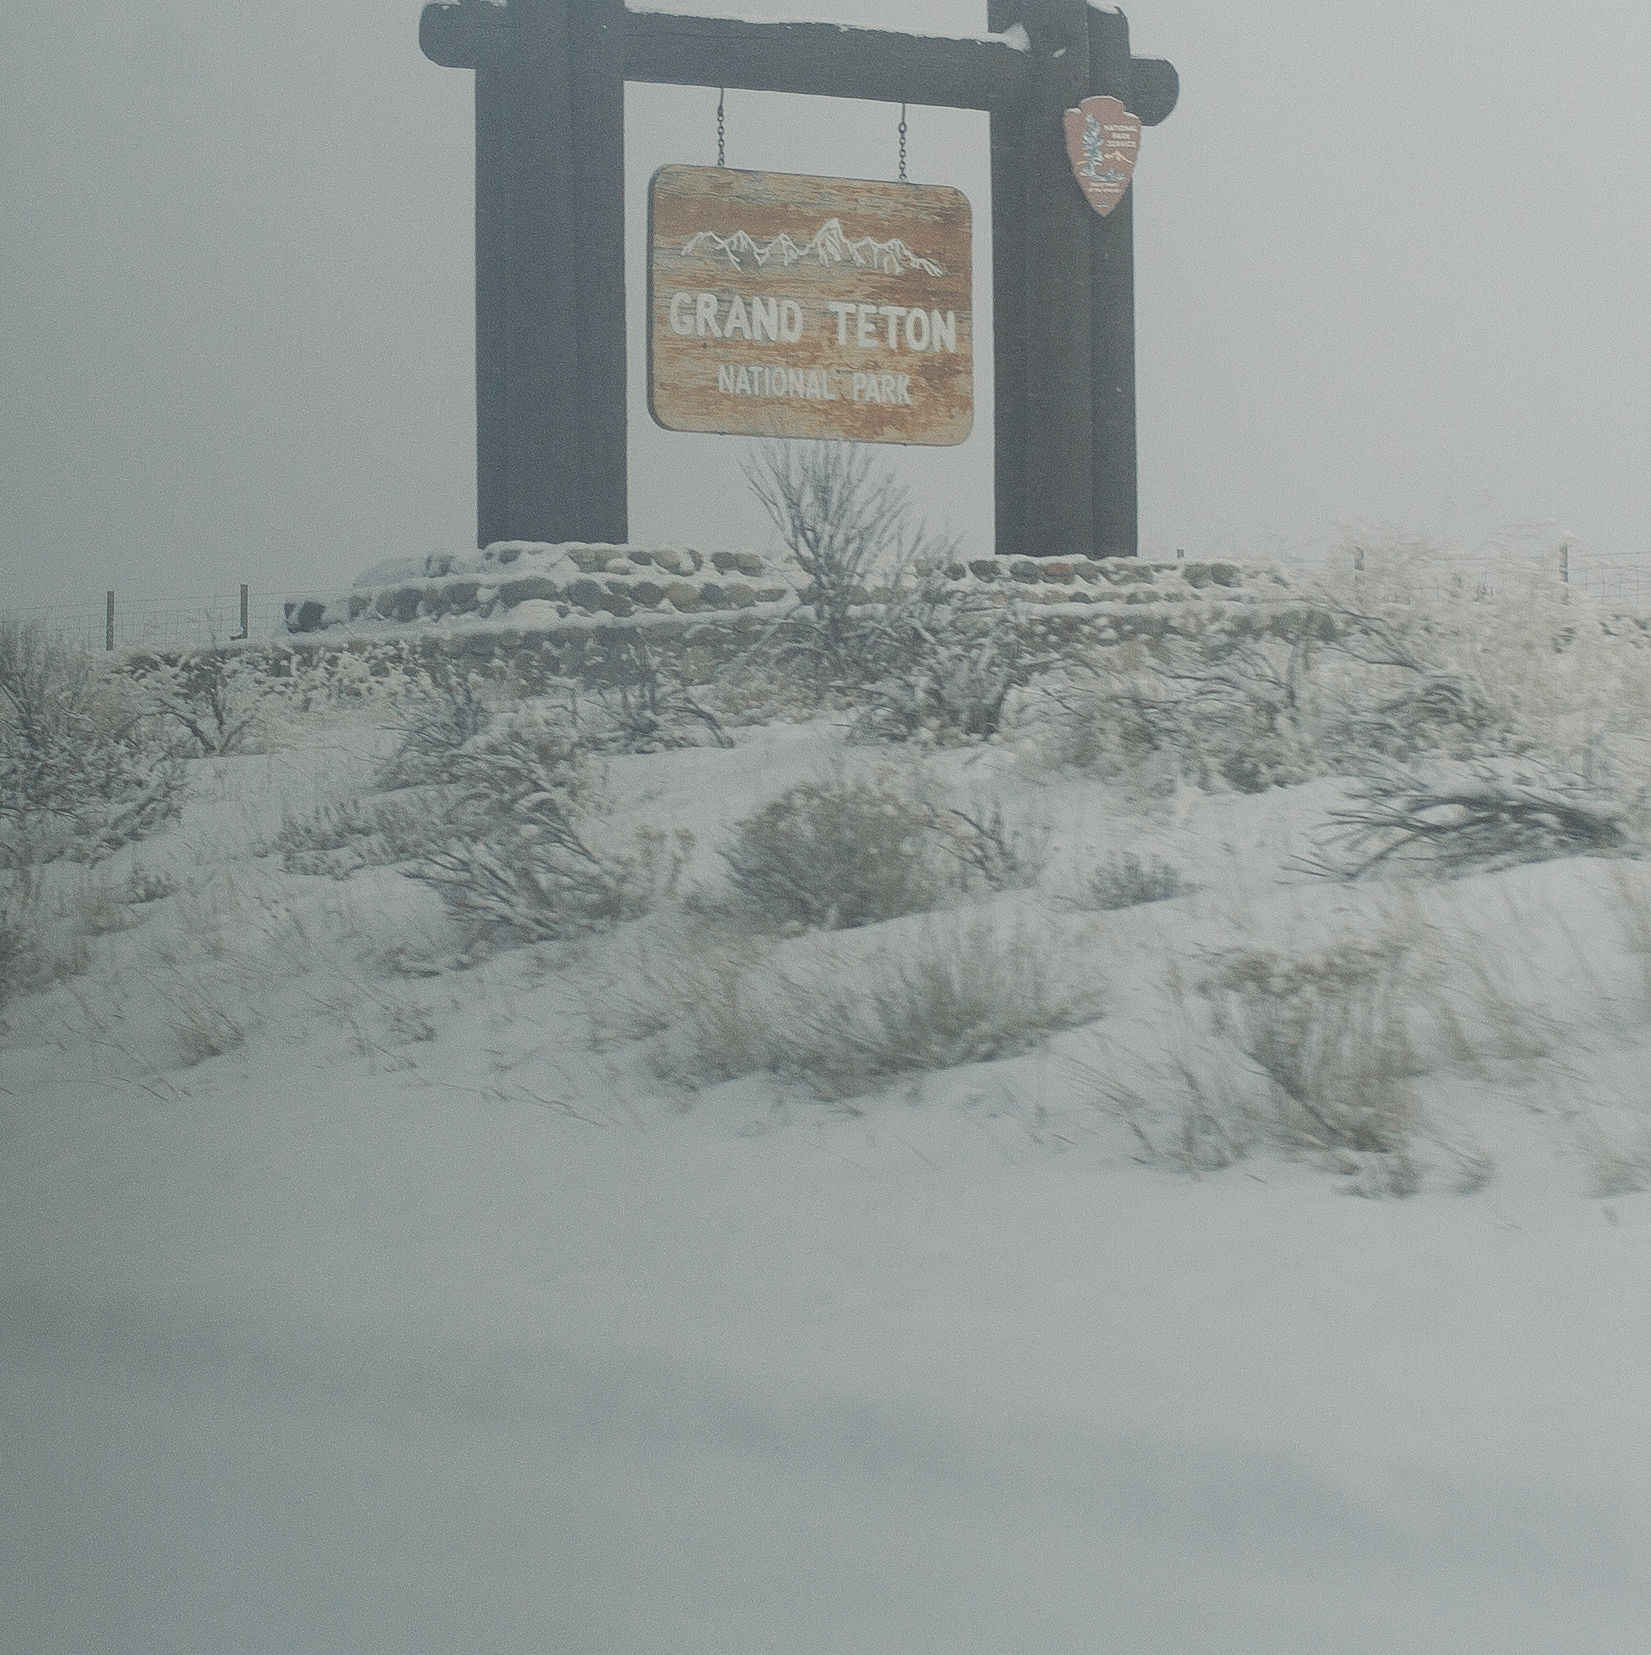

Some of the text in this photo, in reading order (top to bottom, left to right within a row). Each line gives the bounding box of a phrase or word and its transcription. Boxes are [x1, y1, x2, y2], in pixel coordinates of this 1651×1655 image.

[669, 291, 957, 353] GRAND TETON
[717, 363, 911, 405] NATIONAL PARK
